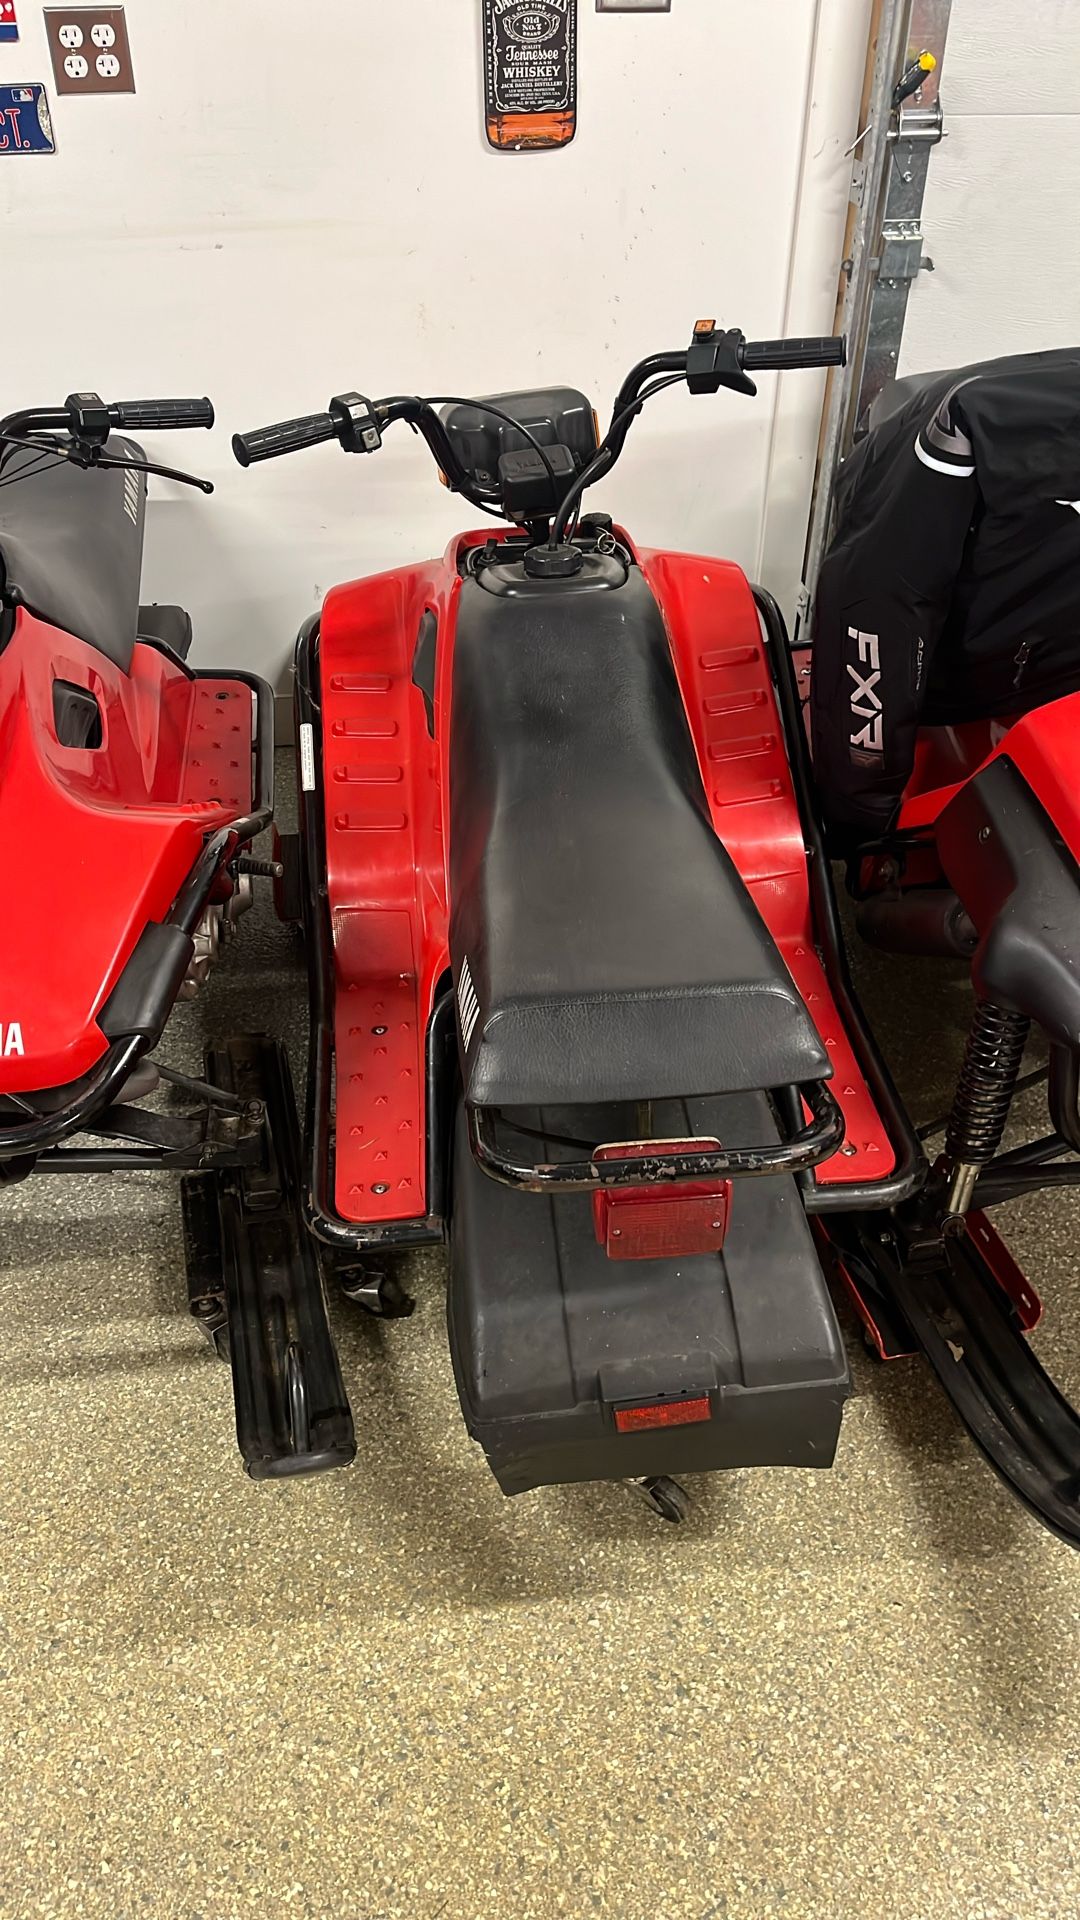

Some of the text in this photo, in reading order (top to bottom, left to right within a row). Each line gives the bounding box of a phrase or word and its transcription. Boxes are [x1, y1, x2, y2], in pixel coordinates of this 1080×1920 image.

[517, 3, 530, 11] OLD
[523, 16, 540, 24] Old
[505, 45, 559, 62] Tennessee
[502, 65, 561, 79] WHISKEY
[846, 626, 884, 751] FXR
